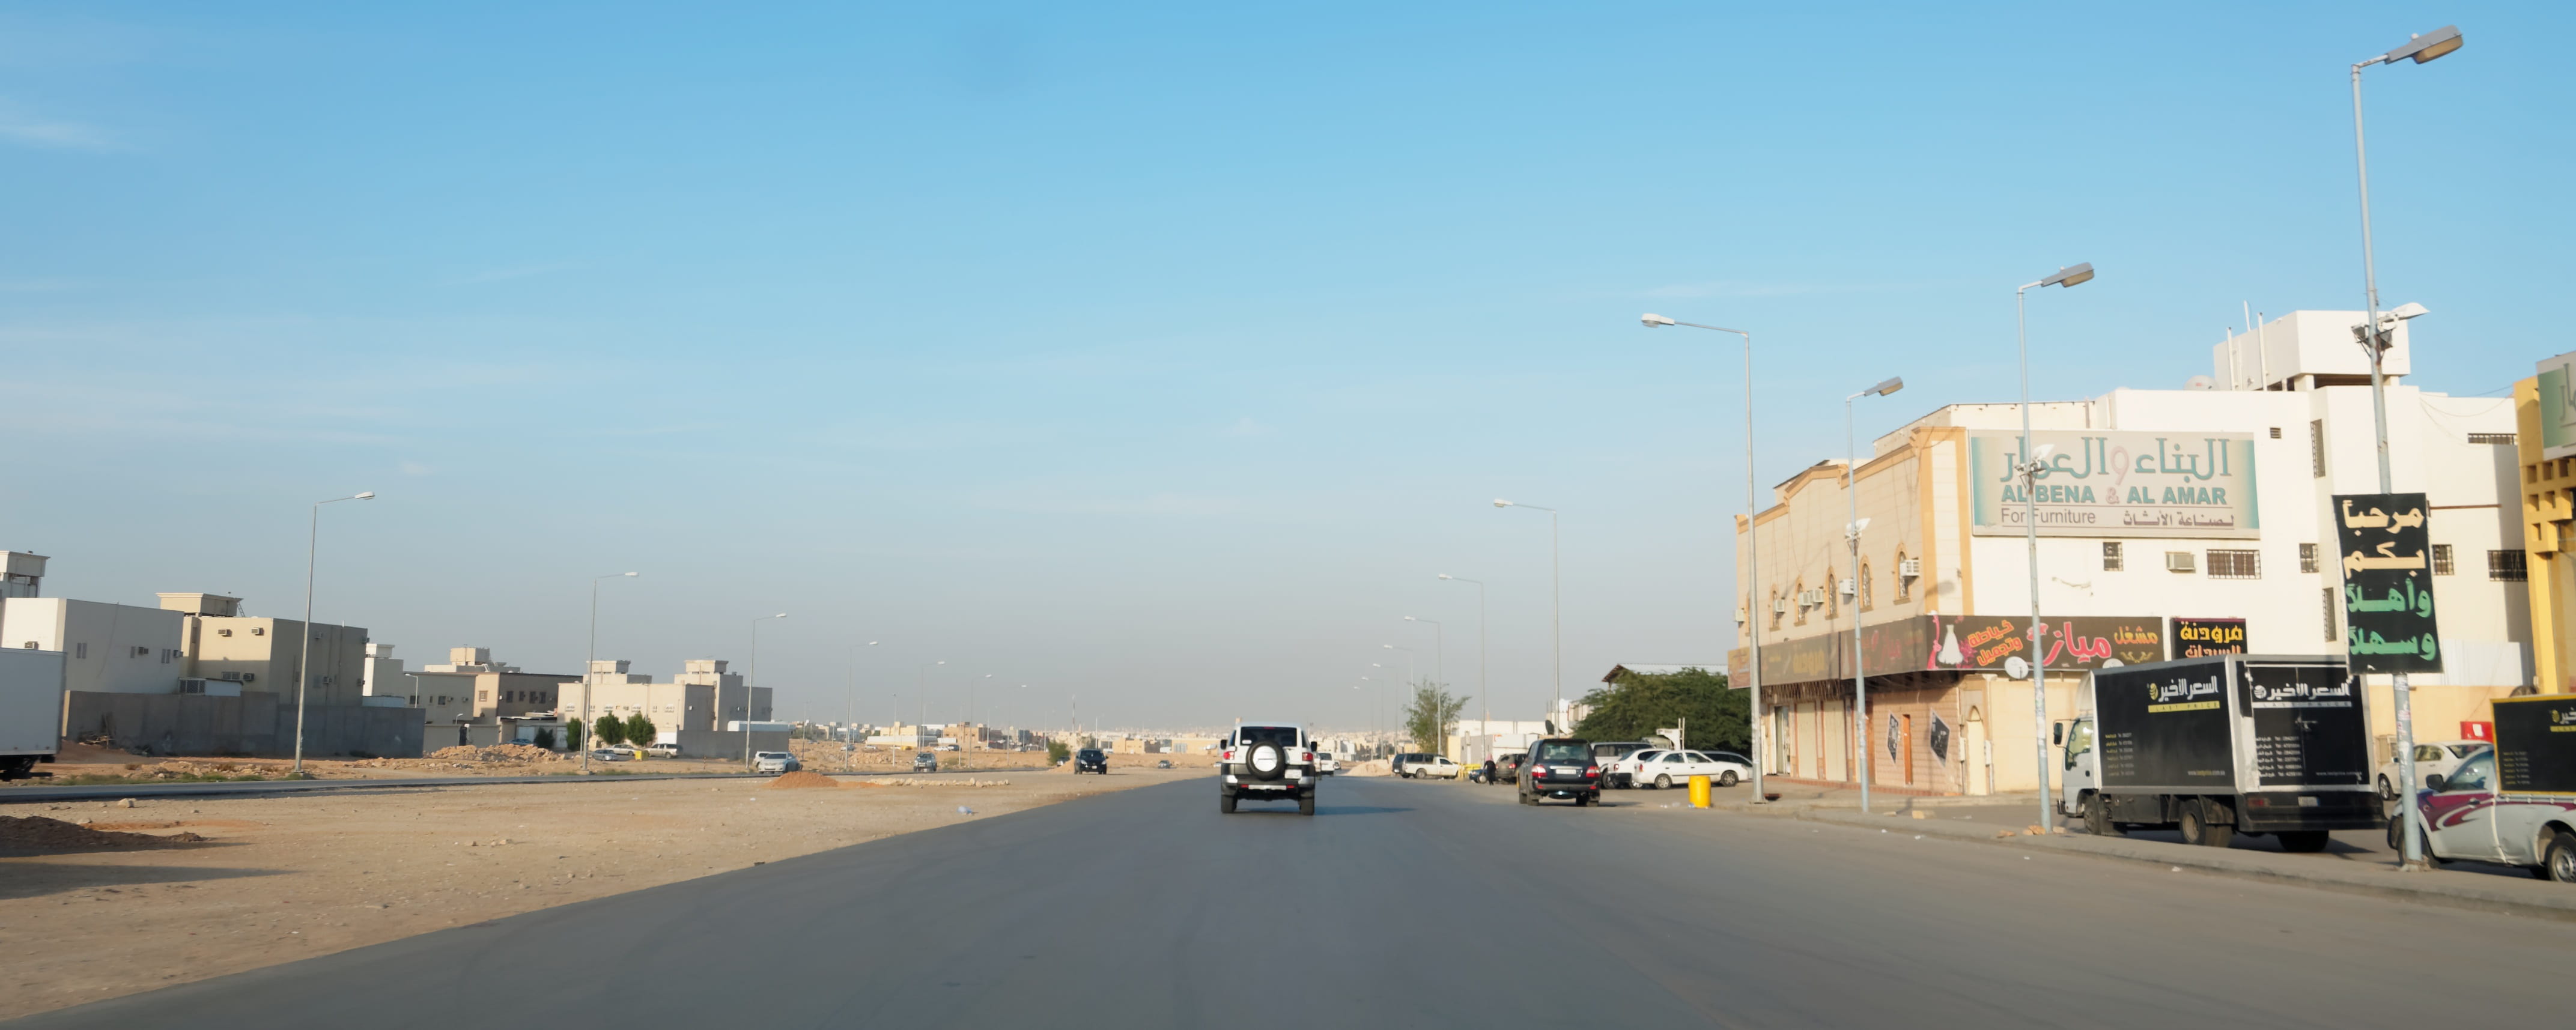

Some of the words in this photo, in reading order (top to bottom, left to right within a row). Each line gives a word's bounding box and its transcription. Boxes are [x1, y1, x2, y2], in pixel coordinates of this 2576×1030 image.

[2134, 438, 2232, 483] البناء
[2001, 485, 2029, 502] AL
[2035, 486, 2096, 503] BENA
[2106, 487, 2119, 504] &
[2127, 486, 2155, 504] AL
[2162, 487, 2227, 505] AMAR
[2001, 508, 2026, 523] For
[2343, 541, 2426, 580] بكم
[1967, 619, 2014, 648] خياطة
[2114, 626, 2158, 644] مشغل
[1976, 637, 2023, 667] وتجميل
[2187, 675, 2219, 700] السعر
[2309, 682, 2350, 700] السعر
